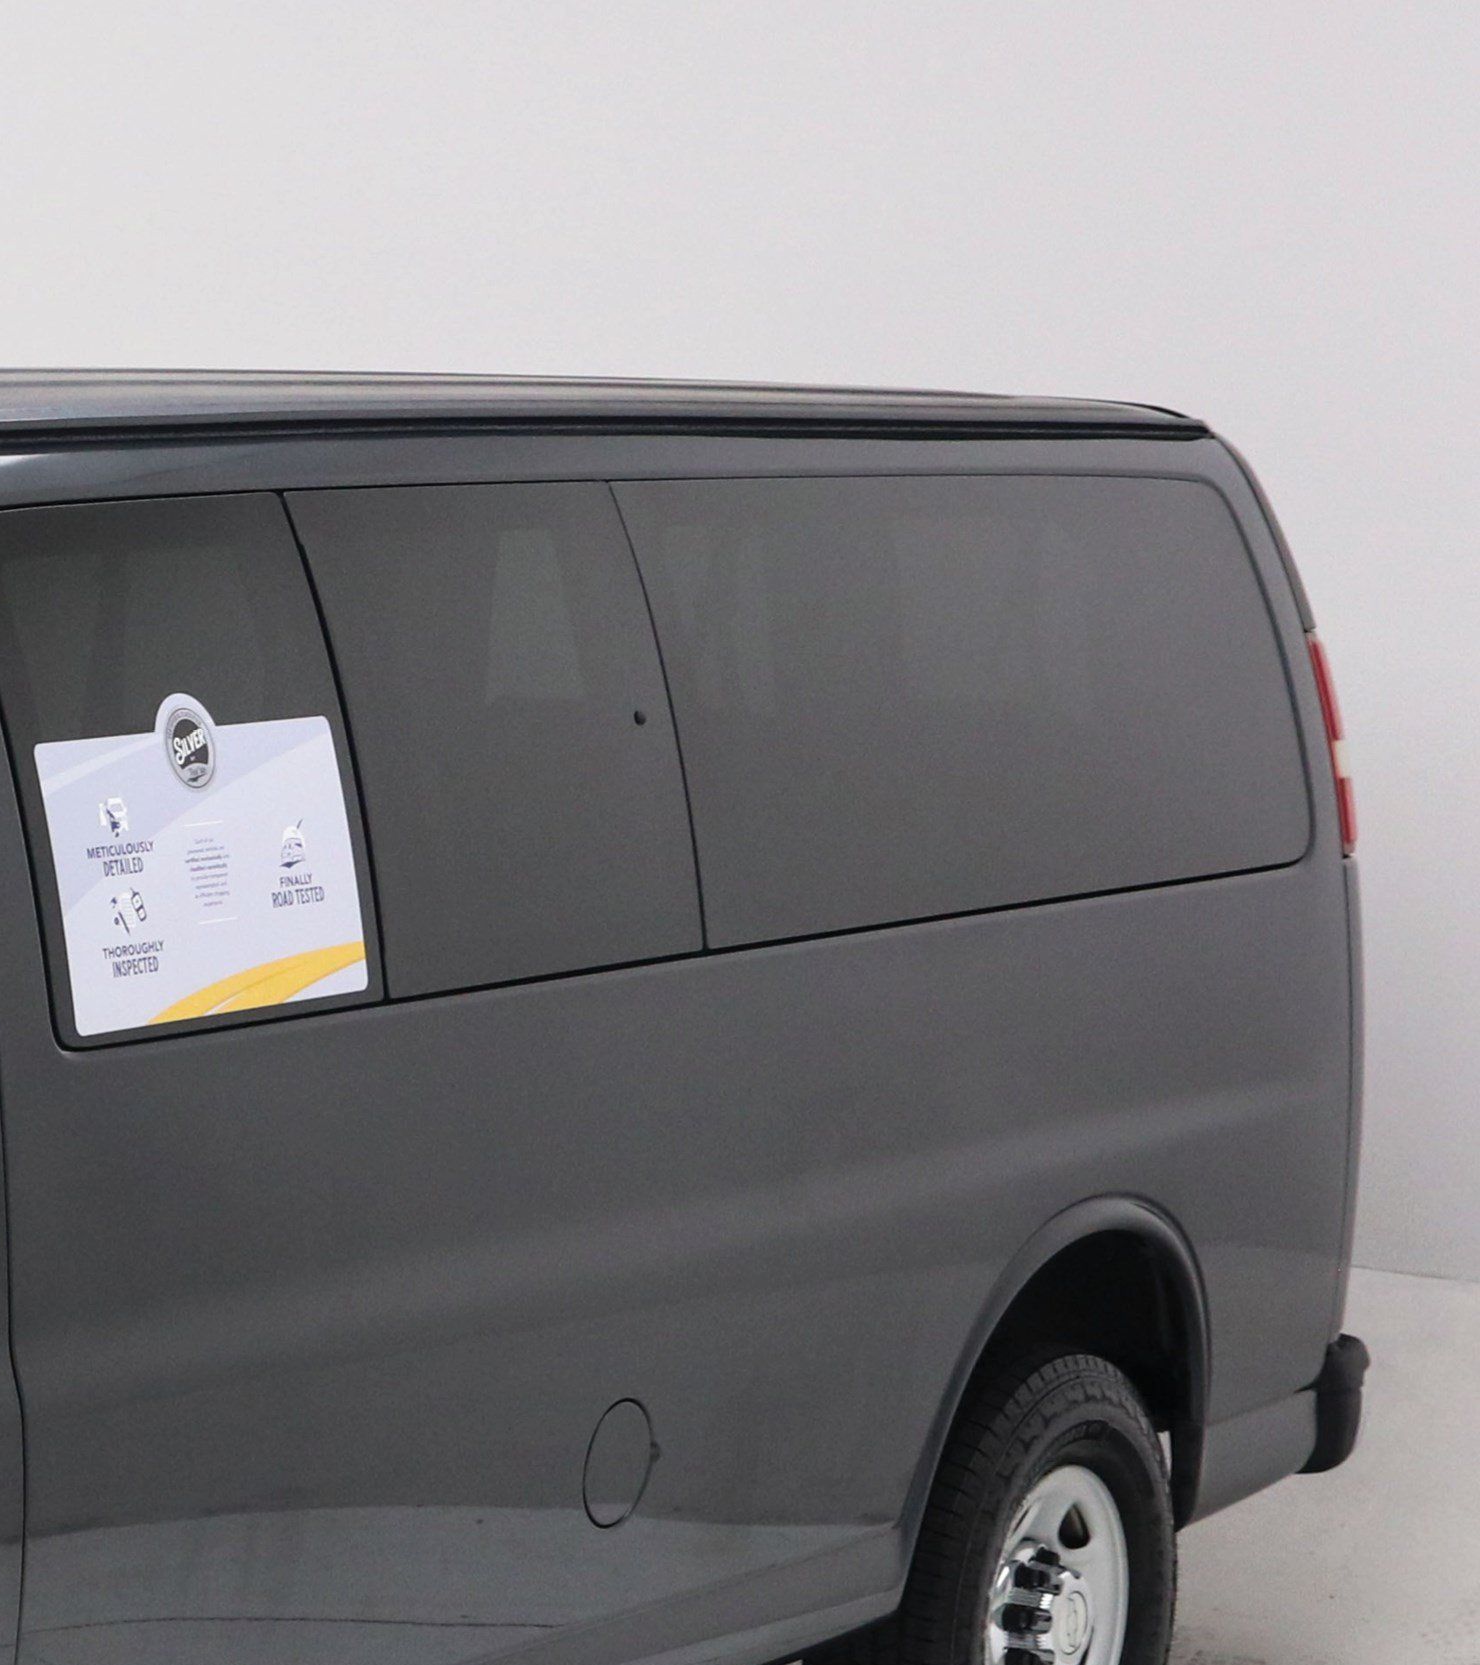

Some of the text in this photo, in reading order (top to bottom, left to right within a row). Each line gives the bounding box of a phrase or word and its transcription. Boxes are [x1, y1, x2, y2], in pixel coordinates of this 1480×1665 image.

[172, 728, 207, 765] SILVER
[86, 840, 154, 859] METICULOUSLY
[103, 857, 144, 877] DETAILED
[280, 872, 312, 887] FINALLY
[271, 886, 325, 908] ROAD TESTED
[102, 940, 164, 960] THOROUGHLY
[112, 956, 159, 978] INSPECTED
